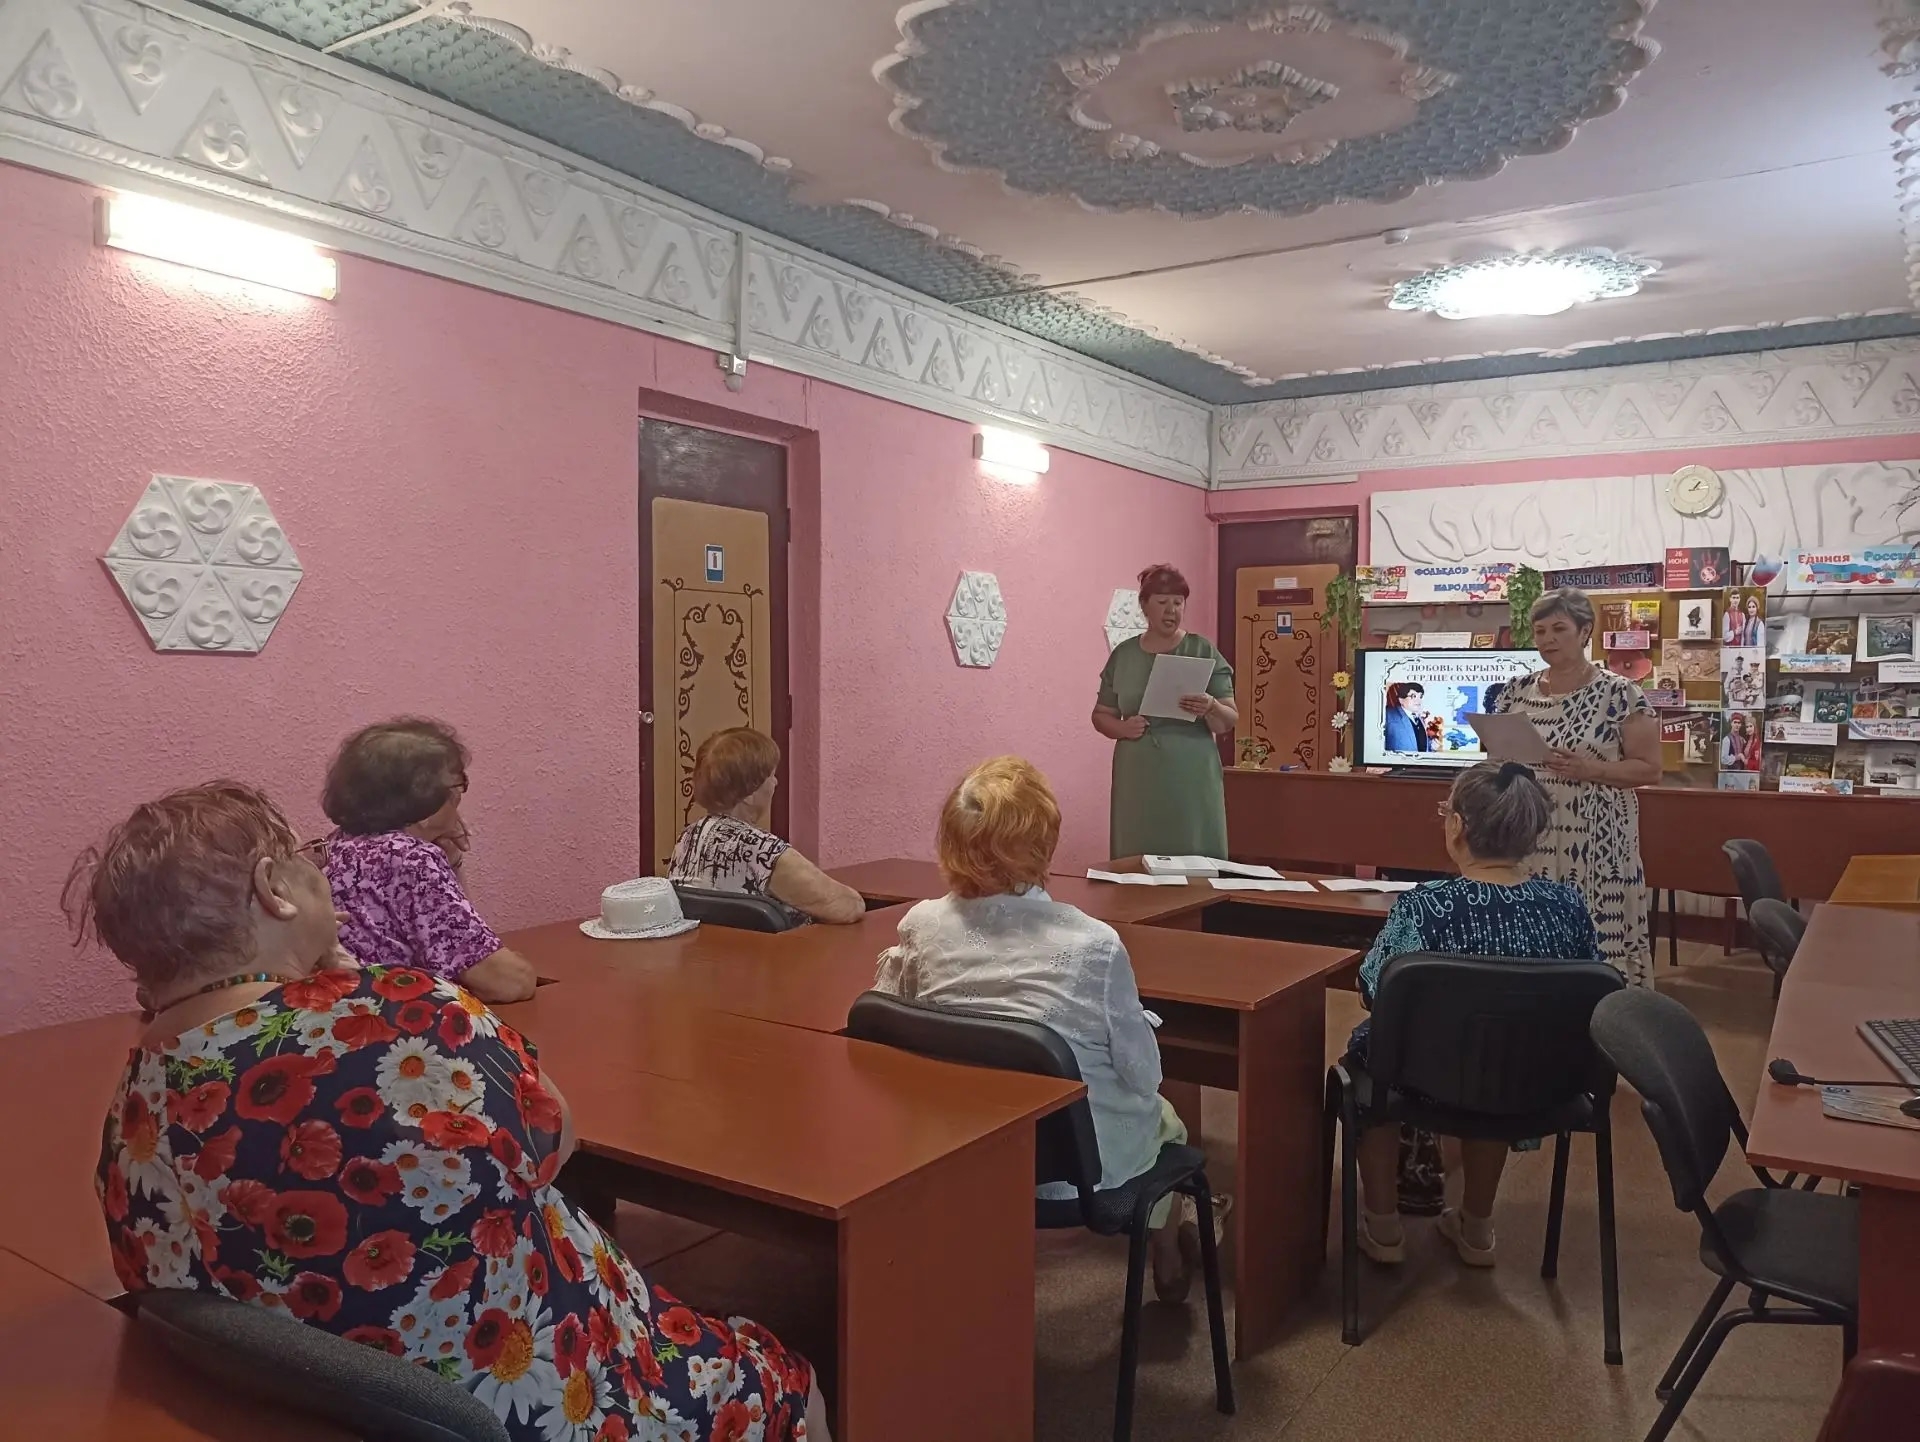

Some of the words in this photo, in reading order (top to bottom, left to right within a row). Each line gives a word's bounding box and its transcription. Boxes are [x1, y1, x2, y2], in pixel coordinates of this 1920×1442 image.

[1797, 553, 1851, 565] Единая
[1414, 565, 1469, 576] ФОЛЬКЛОР
[1552, 574, 1610, 588] РАЗБИТЫЕ
[1617, 570, 1656, 586] МЕЧТЫ
[1407, 664, 1454, 672] ЛЮБОВЬ
[1465, 664, 1507, 672] КРЫМУ
[1509, 664, 1516, 672] В
[1406, 674, 1448, 682] СЕРДЦЕ
[1450, 674, 1506, 682] СОХРАНЮ
[1664, 720, 1693, 734] НЕТ!
